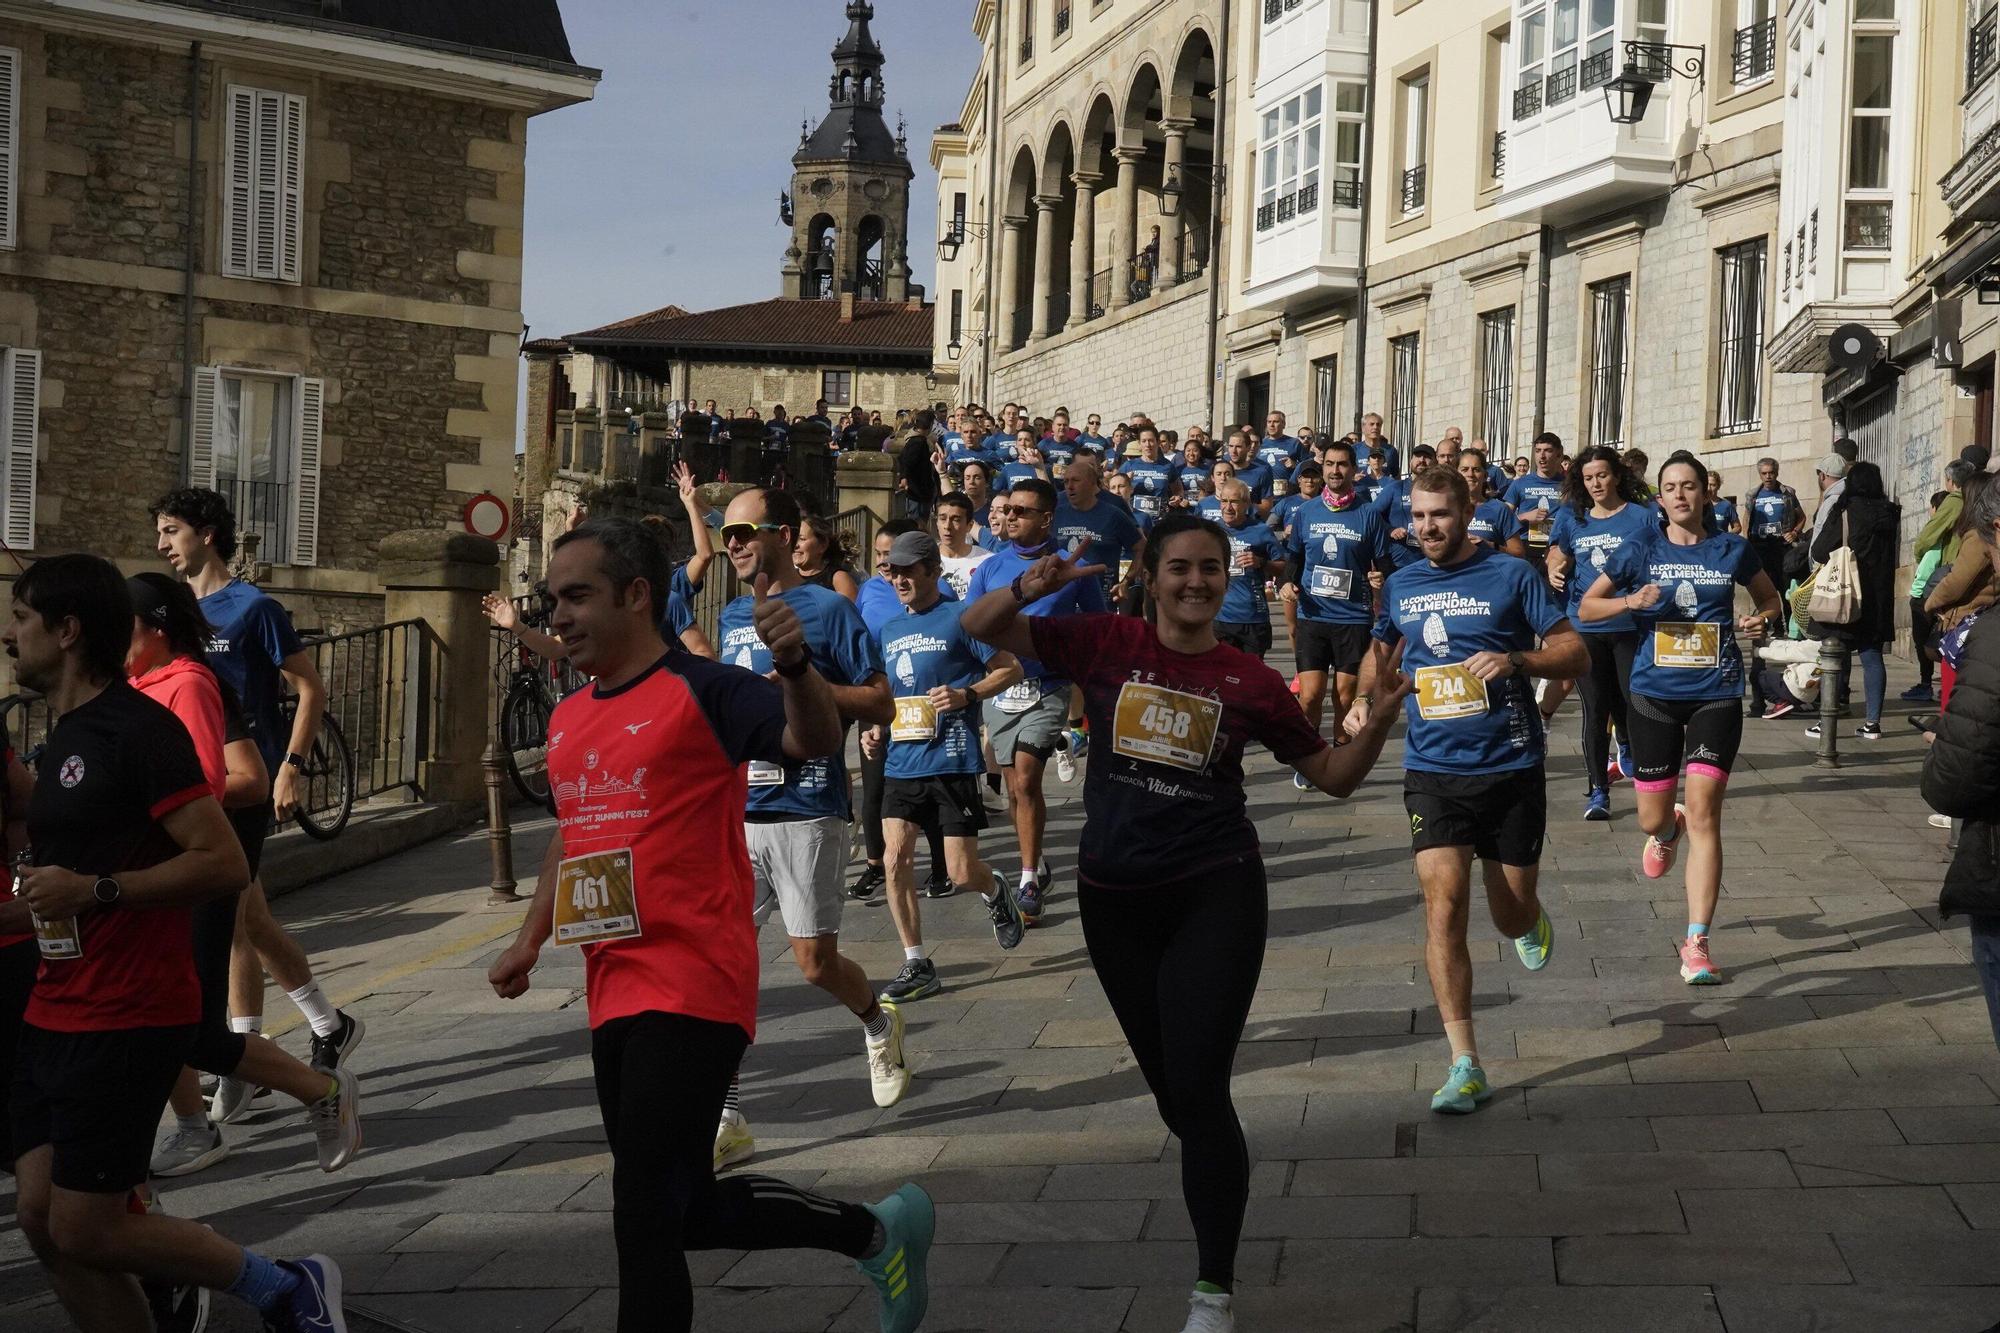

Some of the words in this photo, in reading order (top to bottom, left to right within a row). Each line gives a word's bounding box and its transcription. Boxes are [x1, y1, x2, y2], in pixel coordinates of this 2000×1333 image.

[1964, 387, 1969, 396] 2
[1322, 575, 1340, 587] 978
[1661, 570, 1722, 579] ALMENDRA
[1409, 592, 1458, 604] CONQUISTA
[1409, 598, 1476, 613] ALMENDRA
[1443, 607, 1491, 616] KONKISTA
[891, 636, 936, 654] ALMENDRA
[1673, 633, 1701, 650] 215
[911, 645, 947, 654] KONKISTA
[1432, 677, 1465, 699] 244
[900, 707, 922, 724] 345
[1202, 705, 1214, 714] 10K
[1140, 704, 1191, 738] 458
[1147, 777, 1179, 796] Vital
[574, 815, 592, 824] NIGHT
[595, 811, 624, 822] RUNNING
[626, 810, 649, 819] FEST
[614, 858, 626, 867] 10K
[573, 875, 609, 910] 461
